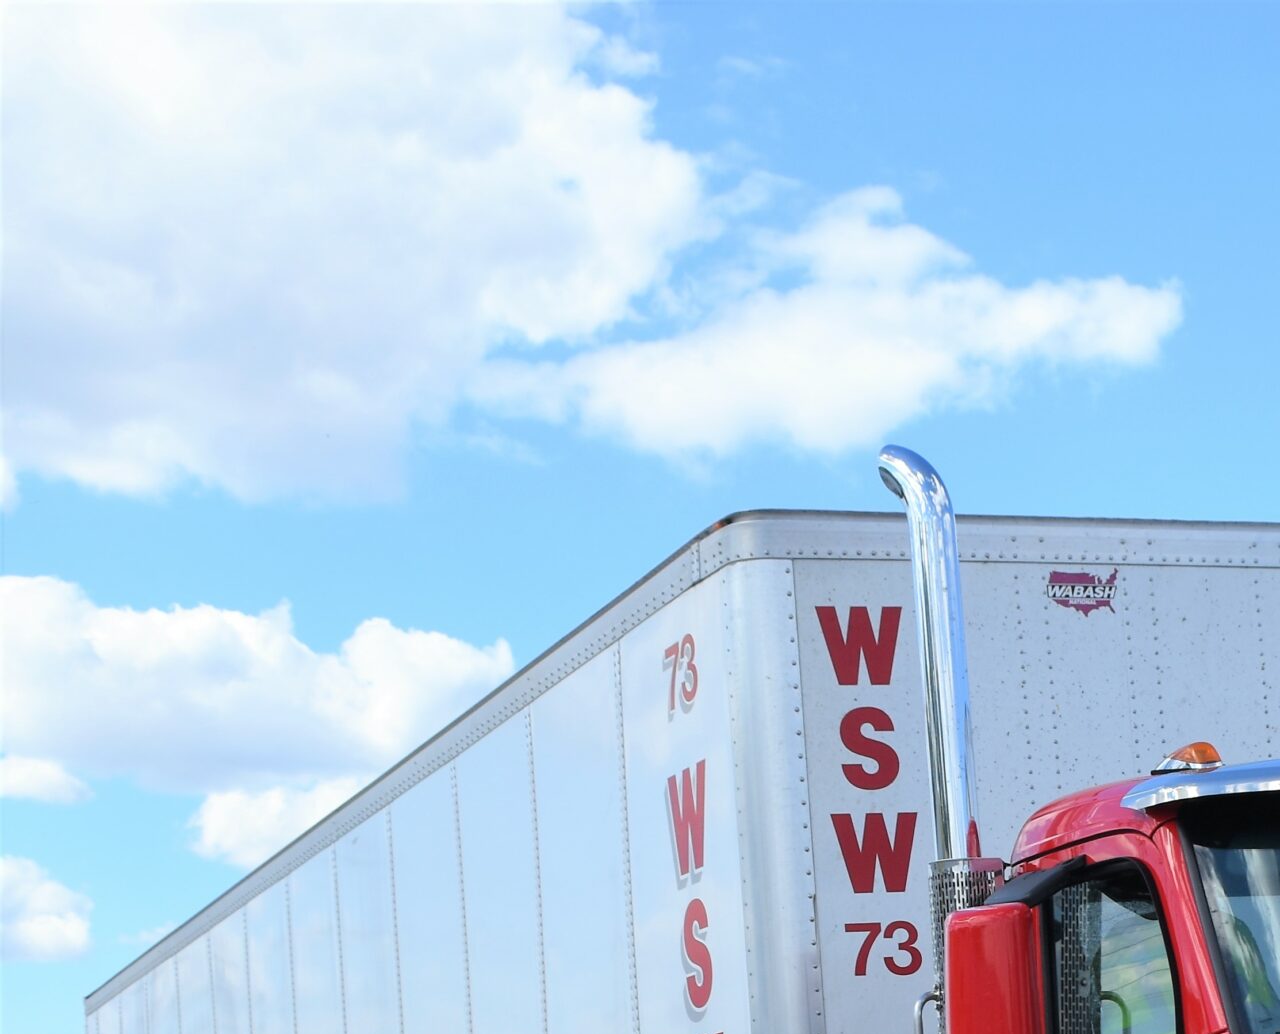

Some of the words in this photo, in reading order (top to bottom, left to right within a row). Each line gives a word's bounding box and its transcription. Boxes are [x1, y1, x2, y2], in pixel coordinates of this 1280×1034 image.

[1047, 584, 1117, 599] WABASH
[663, 632, 699, 714] 73
[844, 920, 922, 976] 73
